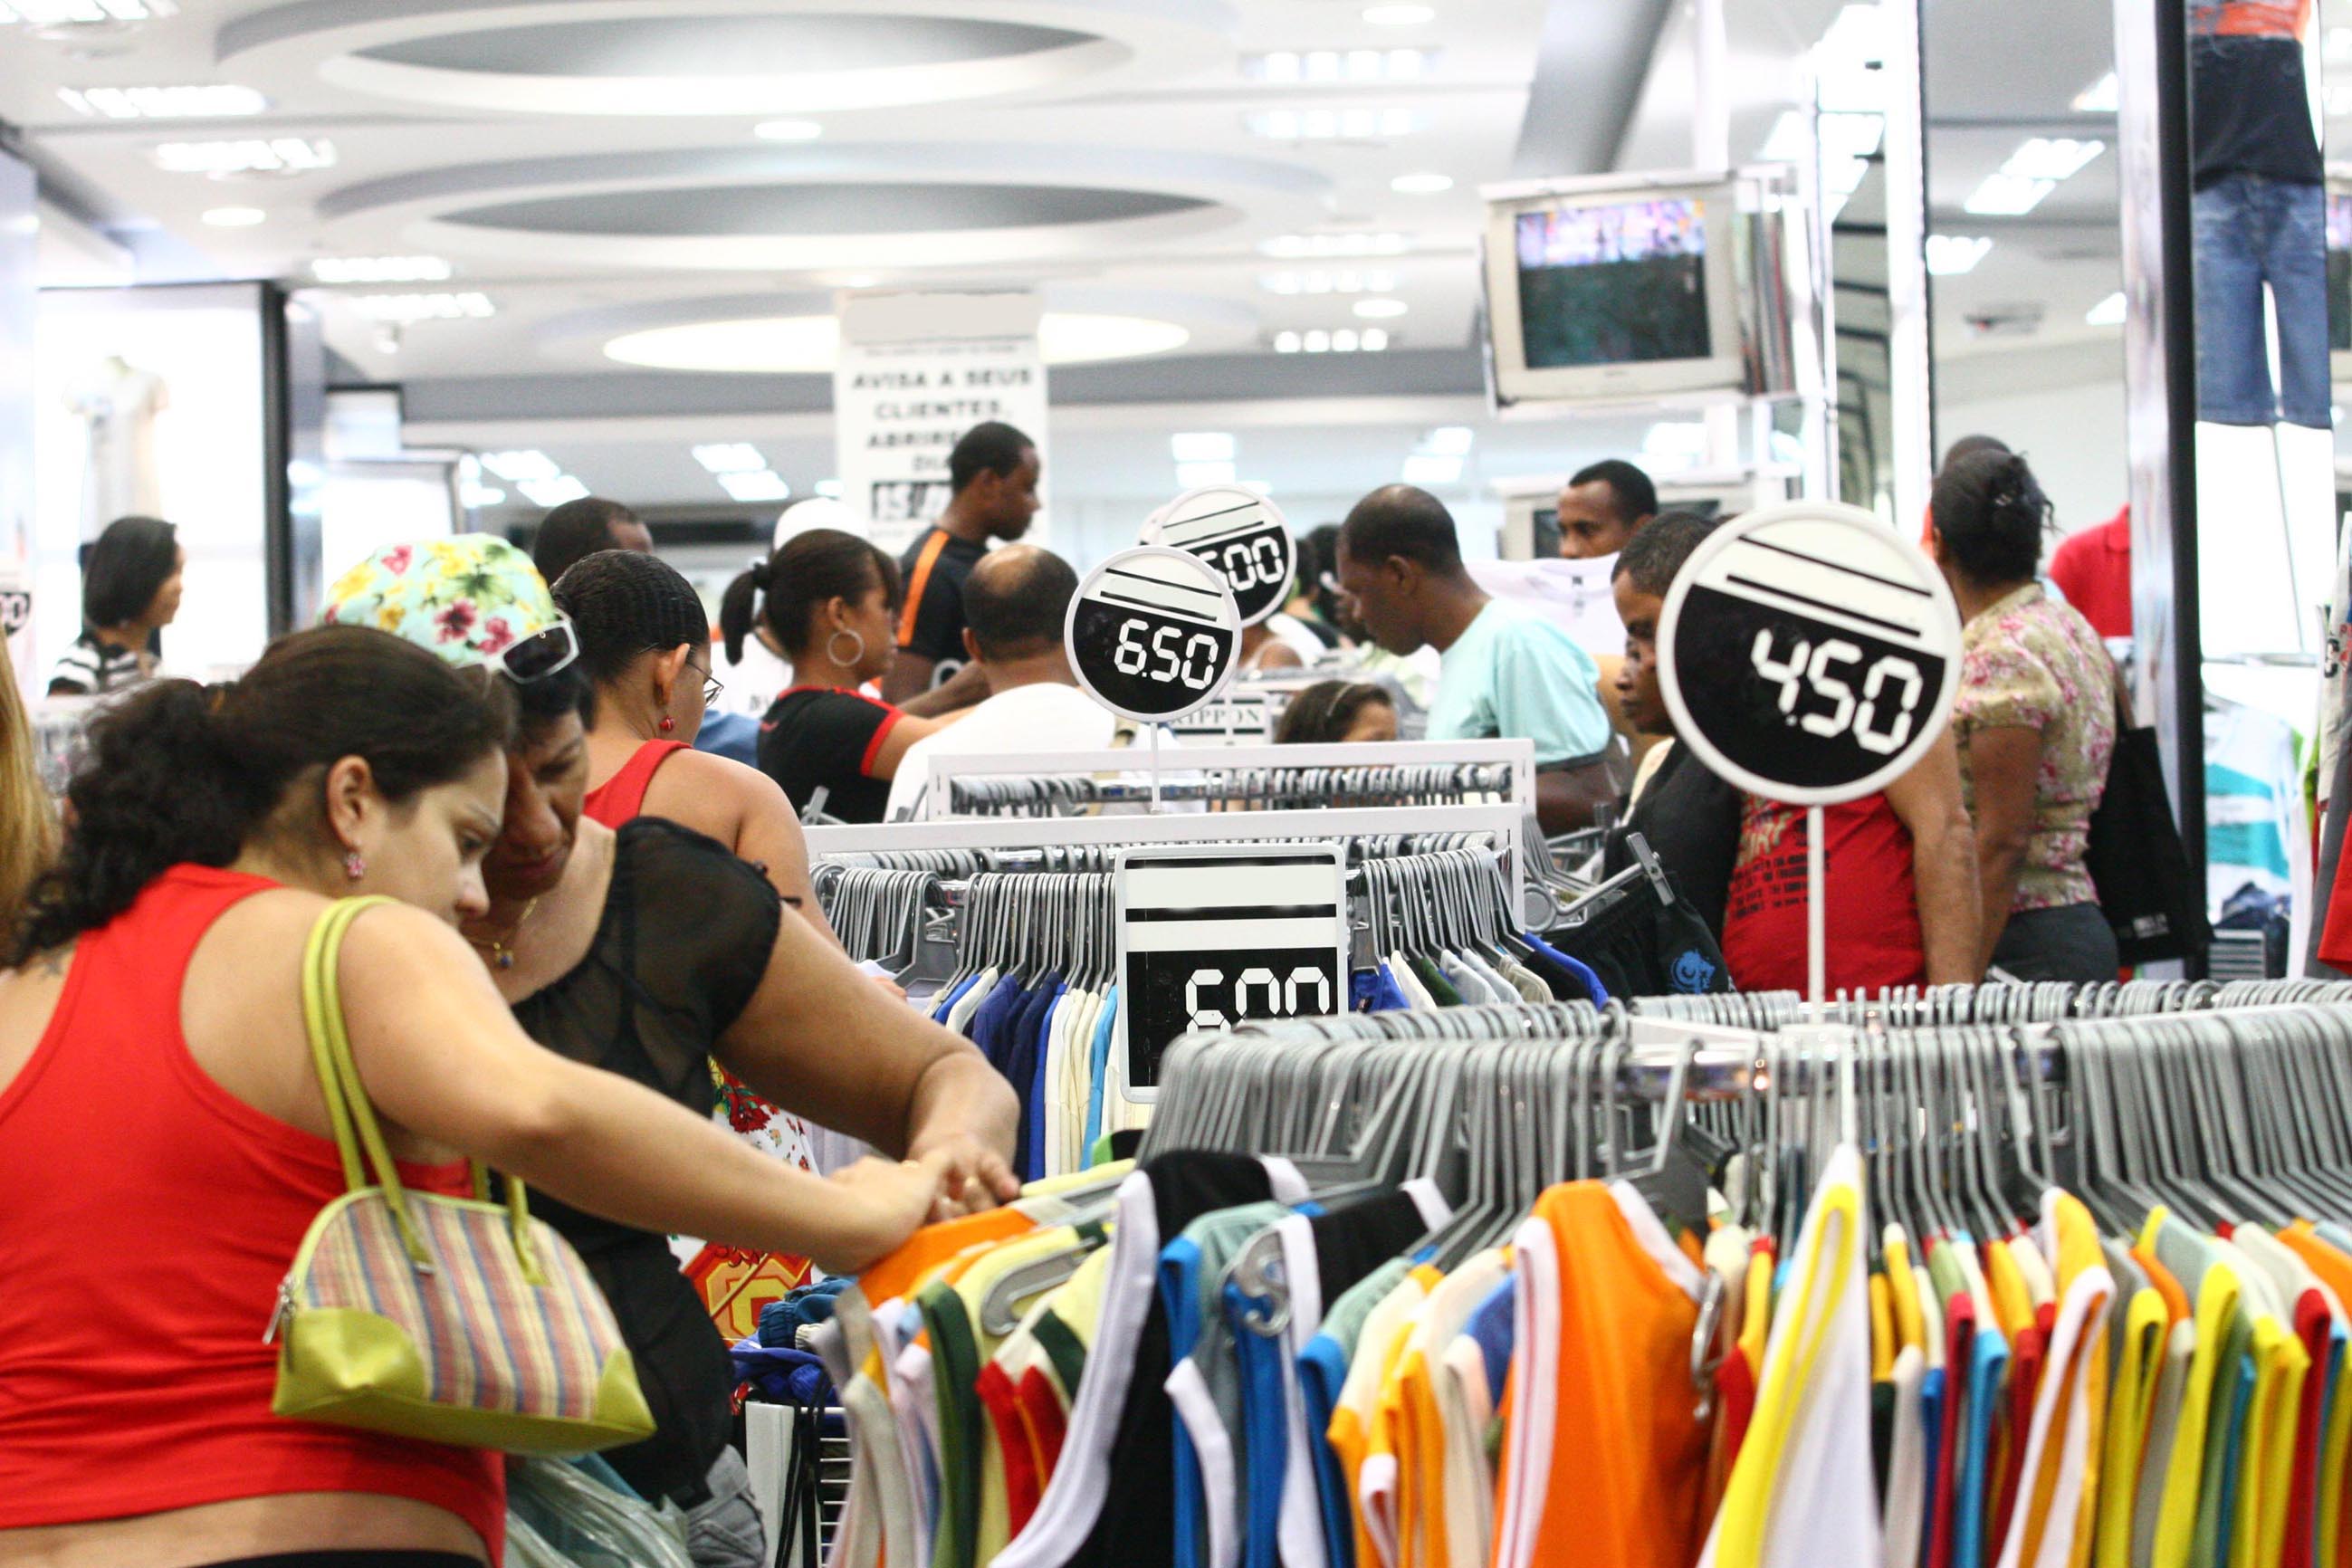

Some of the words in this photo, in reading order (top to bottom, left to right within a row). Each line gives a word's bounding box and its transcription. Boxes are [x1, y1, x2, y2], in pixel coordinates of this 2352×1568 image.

[939, 371, 953, 387] A
[1114, 618, 1219, 690] 6.50
[1751, 628, 1923, 754] 4.50
